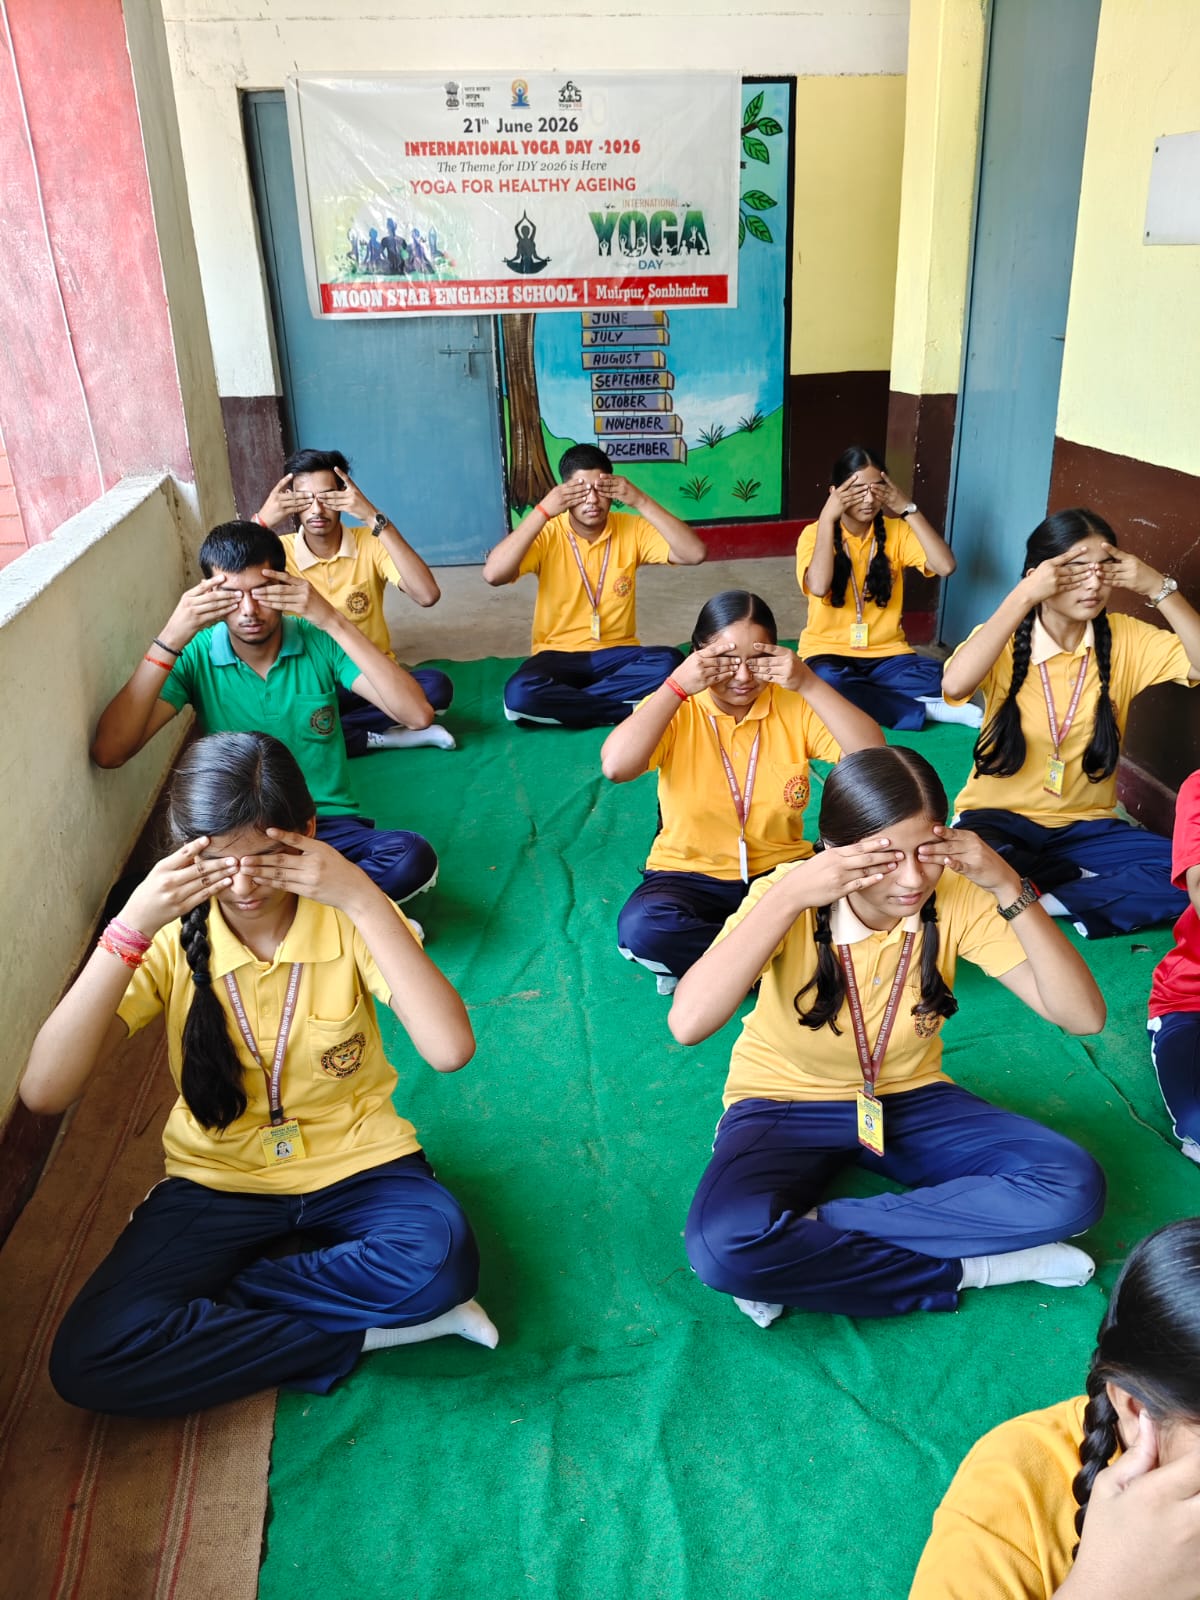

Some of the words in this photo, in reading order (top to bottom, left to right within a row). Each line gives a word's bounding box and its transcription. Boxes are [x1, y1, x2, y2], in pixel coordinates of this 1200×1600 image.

[463, 117, 489, 133] 21th
[496, 117, 533, 133] June
[538, 117, 578, 133] 2026
[404, 140, 519, 157] INTERNATIONAL
[521, 139, 560, 155] YOGA
[565, 139, 593, 154] DAY
[598, 139, 641, 154] -2026
[437, 161, 457, 173] The
[460, 161, 496, 173] Theme
[496, 160, 514, 174] for
[517, 161, 538, 171] IDY
[540, 161, 567, 171] 2026
[570, 160, 578, 171] is
[581, 160, 607, 171] Here
[409, 179, 457, 194] YOGA
[461, 179, 494, 194] FOR
[499, 178, 571, 193] HEALTHY
[575, 177, 636, 192] AGEING
[623, 199, 680, 209] INTERNATIONAL
[588, 210, 711, 257] YOGA
[638, 260, 664, 270] DAY
[331, 289, 383, 308] MOON
[387, 287, 431, 307] STAR
[434, 285, 509, 305] ENGLISH
[512, 284, 578, 303] SCHOOL
[596, 284, 645, 300] Muirpur,
[648, 282, 709, 298] Sonbhadra
[591, 312, 628, 325] JUNE
[590, 331, 623, 343] JULY
[593, 353, 640, 365] AUGUST
[595, 373, 661, 388] SEPTEMBER
[595, 395, 647, 408] OCTOBER
[605, 417, 663, 430] NOVEMBER
[606, 442, 670, 456] DECEMBER
